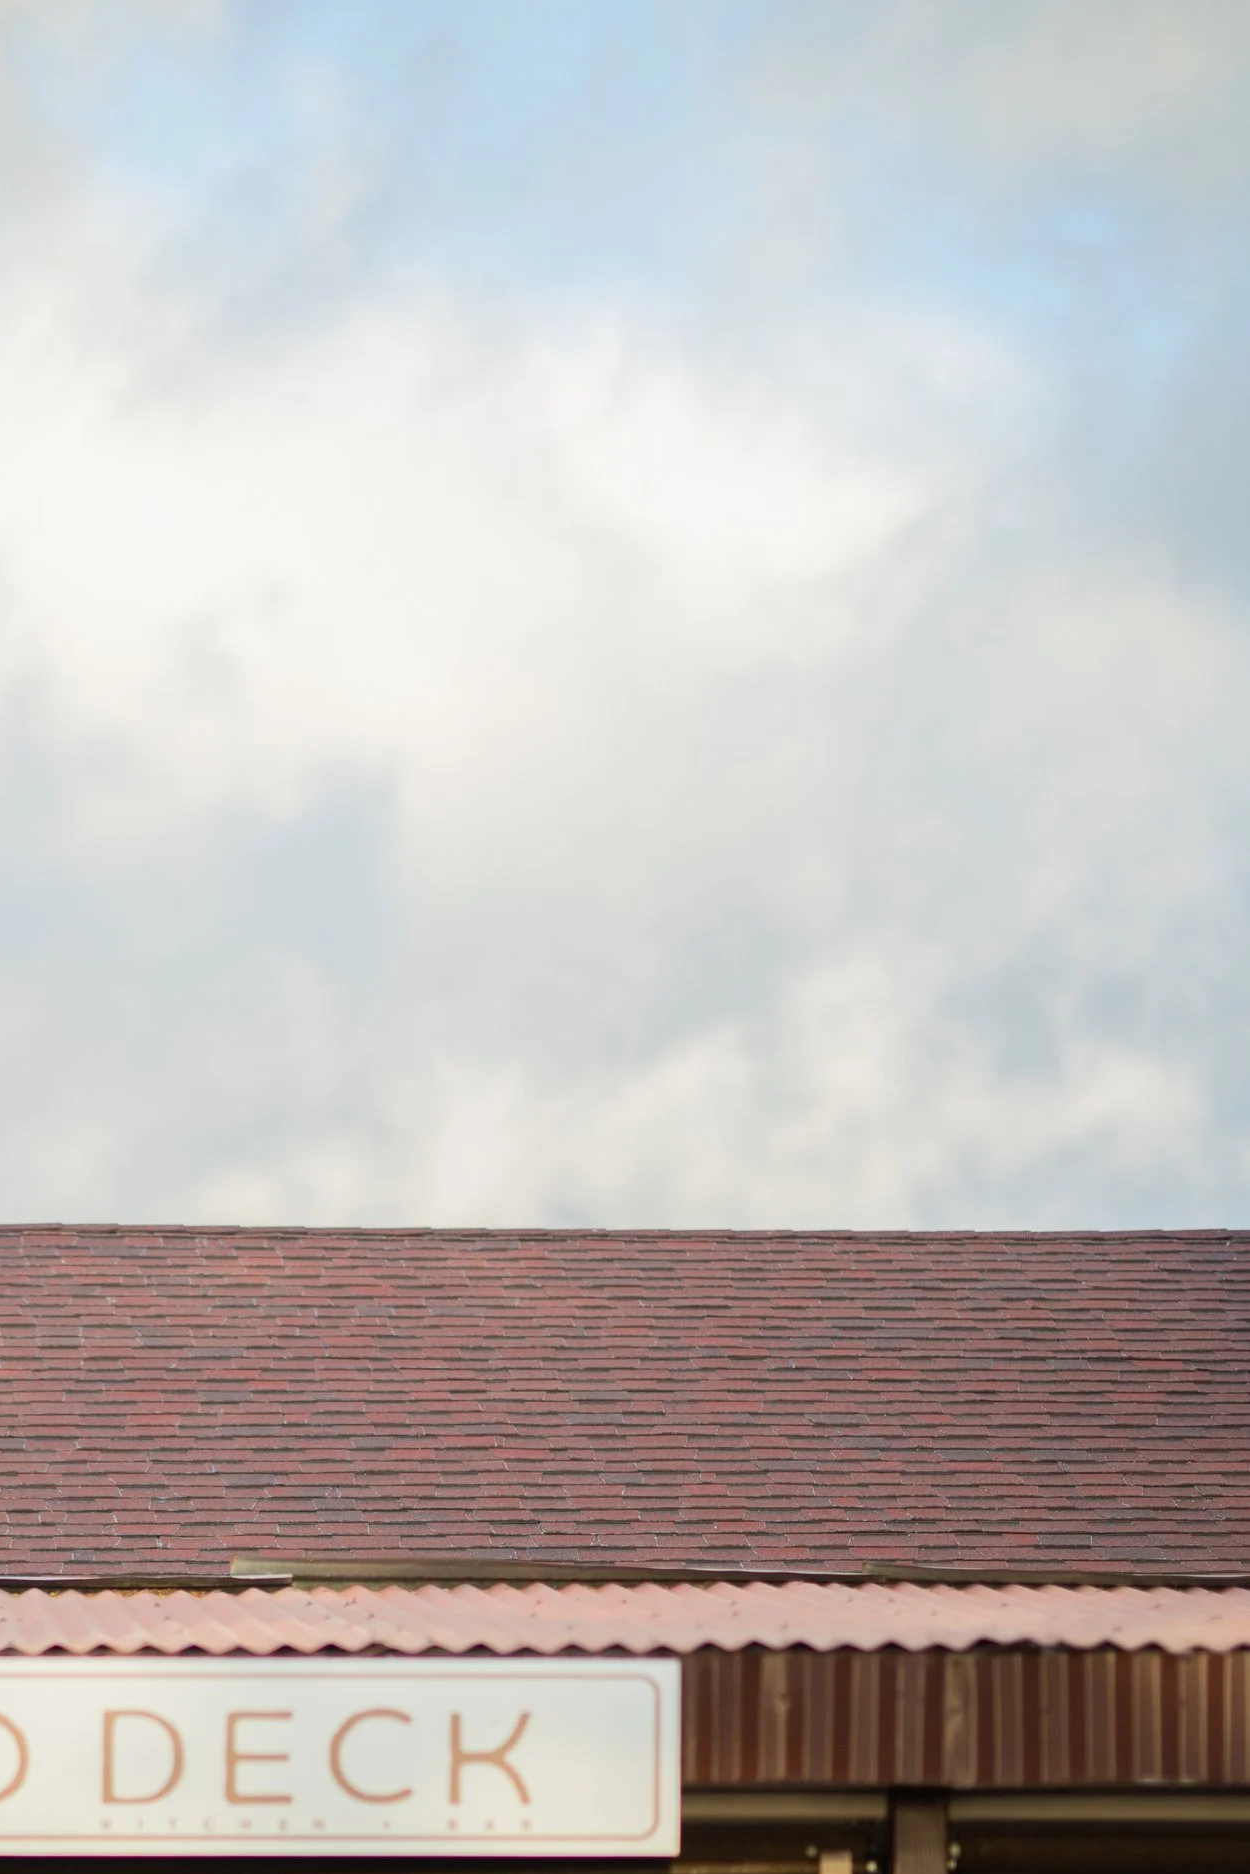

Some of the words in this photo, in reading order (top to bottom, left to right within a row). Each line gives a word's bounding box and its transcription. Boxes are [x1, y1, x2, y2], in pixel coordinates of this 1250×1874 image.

[101, 1707, 533, 1806] DECK
[99, 1815, 329, 1833] KITCHEN
[445, 1815, 533, 1833] BAR
